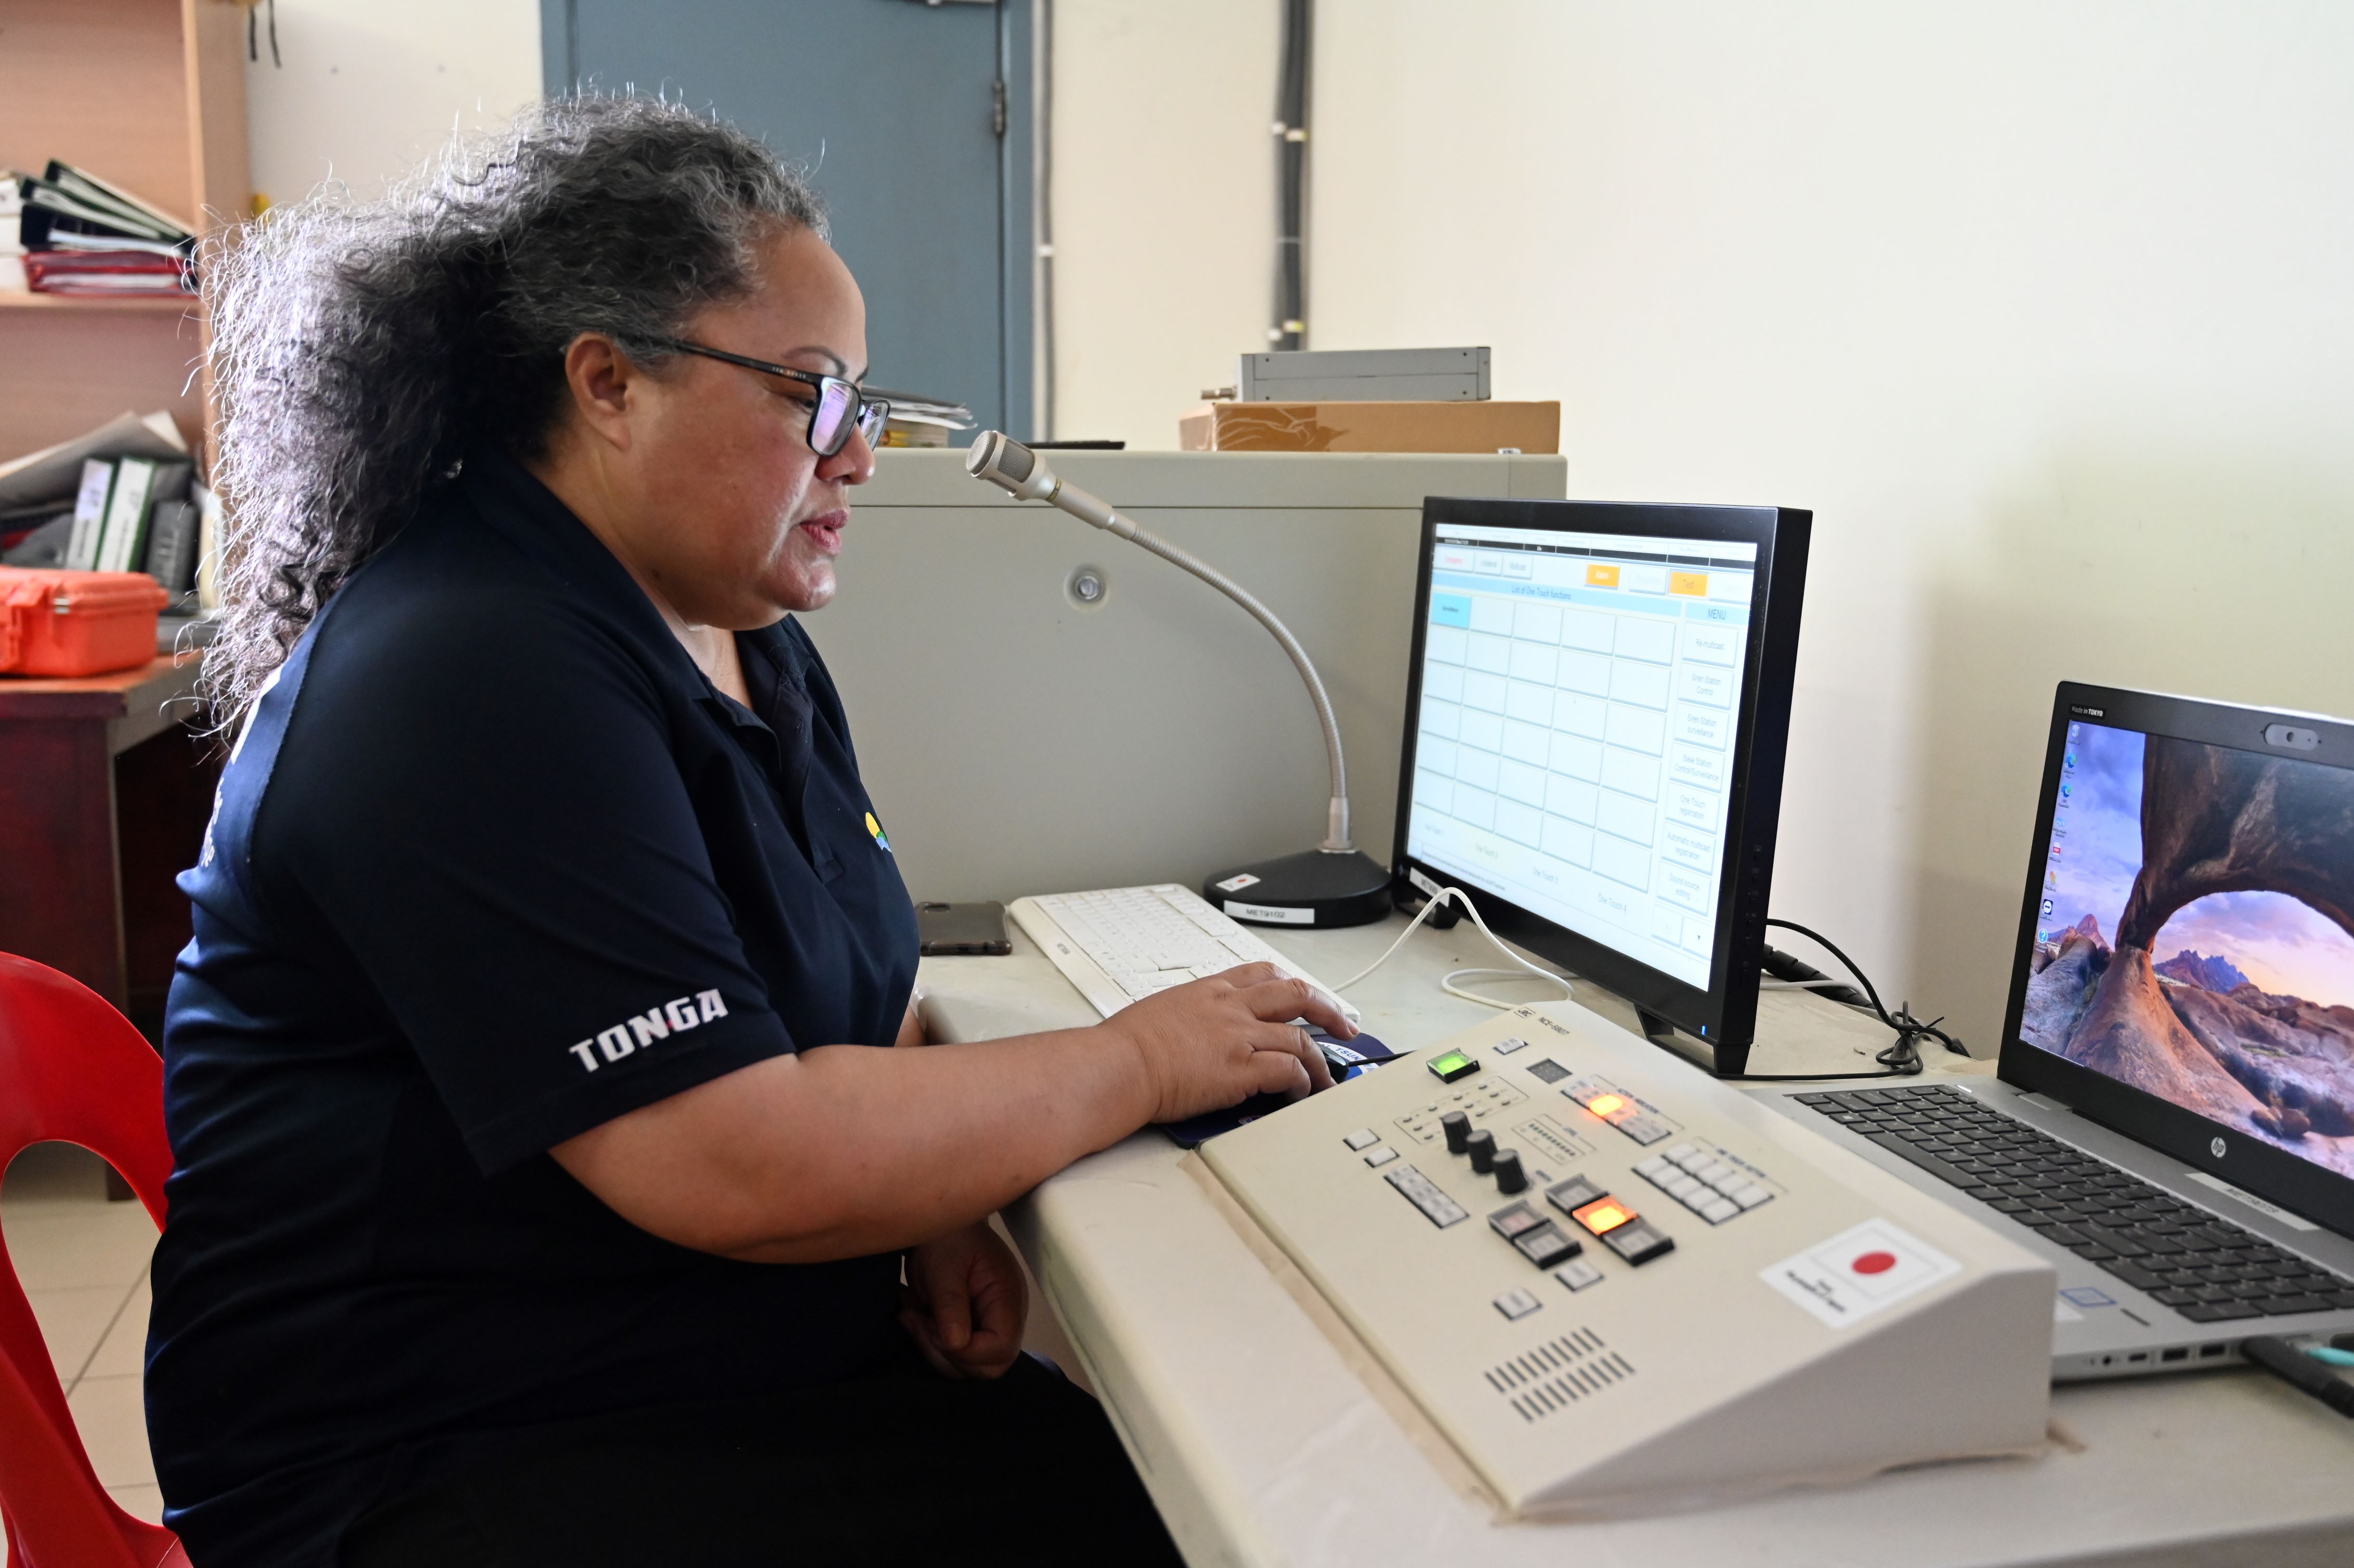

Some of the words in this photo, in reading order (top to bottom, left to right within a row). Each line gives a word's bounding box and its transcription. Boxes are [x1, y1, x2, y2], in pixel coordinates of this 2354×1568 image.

[1509, 561, 1526, 571] Multicast
[1683, 579, 1694, 590] Test
[1512, 585, 1521, 593] List
[1526, 586, 1535, 595] One
[1537, 587, 1549, 597] Touch
[1550, 589, 1571, 600] functions
[1708, 608, 1727, 620] MENU
[1695, 638, 1724, 651] Re-multicast
[1692, 674, 1703, 683] Siren
[1705, 675, 1721, 686] Station
[1696, 686, 1714, 696] Control
[2072, 705, 2083, 714] Made
[2088, 708, 2103, 717] TOKYO
[1687, 714, 1699, 723] Siren
[1701, 717, 1717, 727] Station
[1687, 727, 1714, 738] surveillance
[1683, 754, 1695, 764] Base
[1696, 757, 1712, 768] Station
[1674, 763, 1719, 781] Control/Surveillance
[1681, 794, 1690, 804] One
[1691, 798, 1706, 808] Touch
[1679, 807, 1705, 819] registration
[1667, 832, 1690, 846] Automatic
[1690, 840, 1710, 853] multicast
[1675, 846, 1701, 860] registration
[1532, 867, 1541, 877] One
[1542, 870, 1554, 882] Touch
[1554, 876, 1559, 884] 3
[1669, 873, 1684, 886] Sound
[1684, 880, 1701, 891] source
[1676, 888, 1691, 901] editing
[1598, 893, 1607, 906] One
[1608, 898, 1623, 911] Touch
[1247, 908, 1285, 918] MET9102
[569, 988, 728, 1072] TONGA
